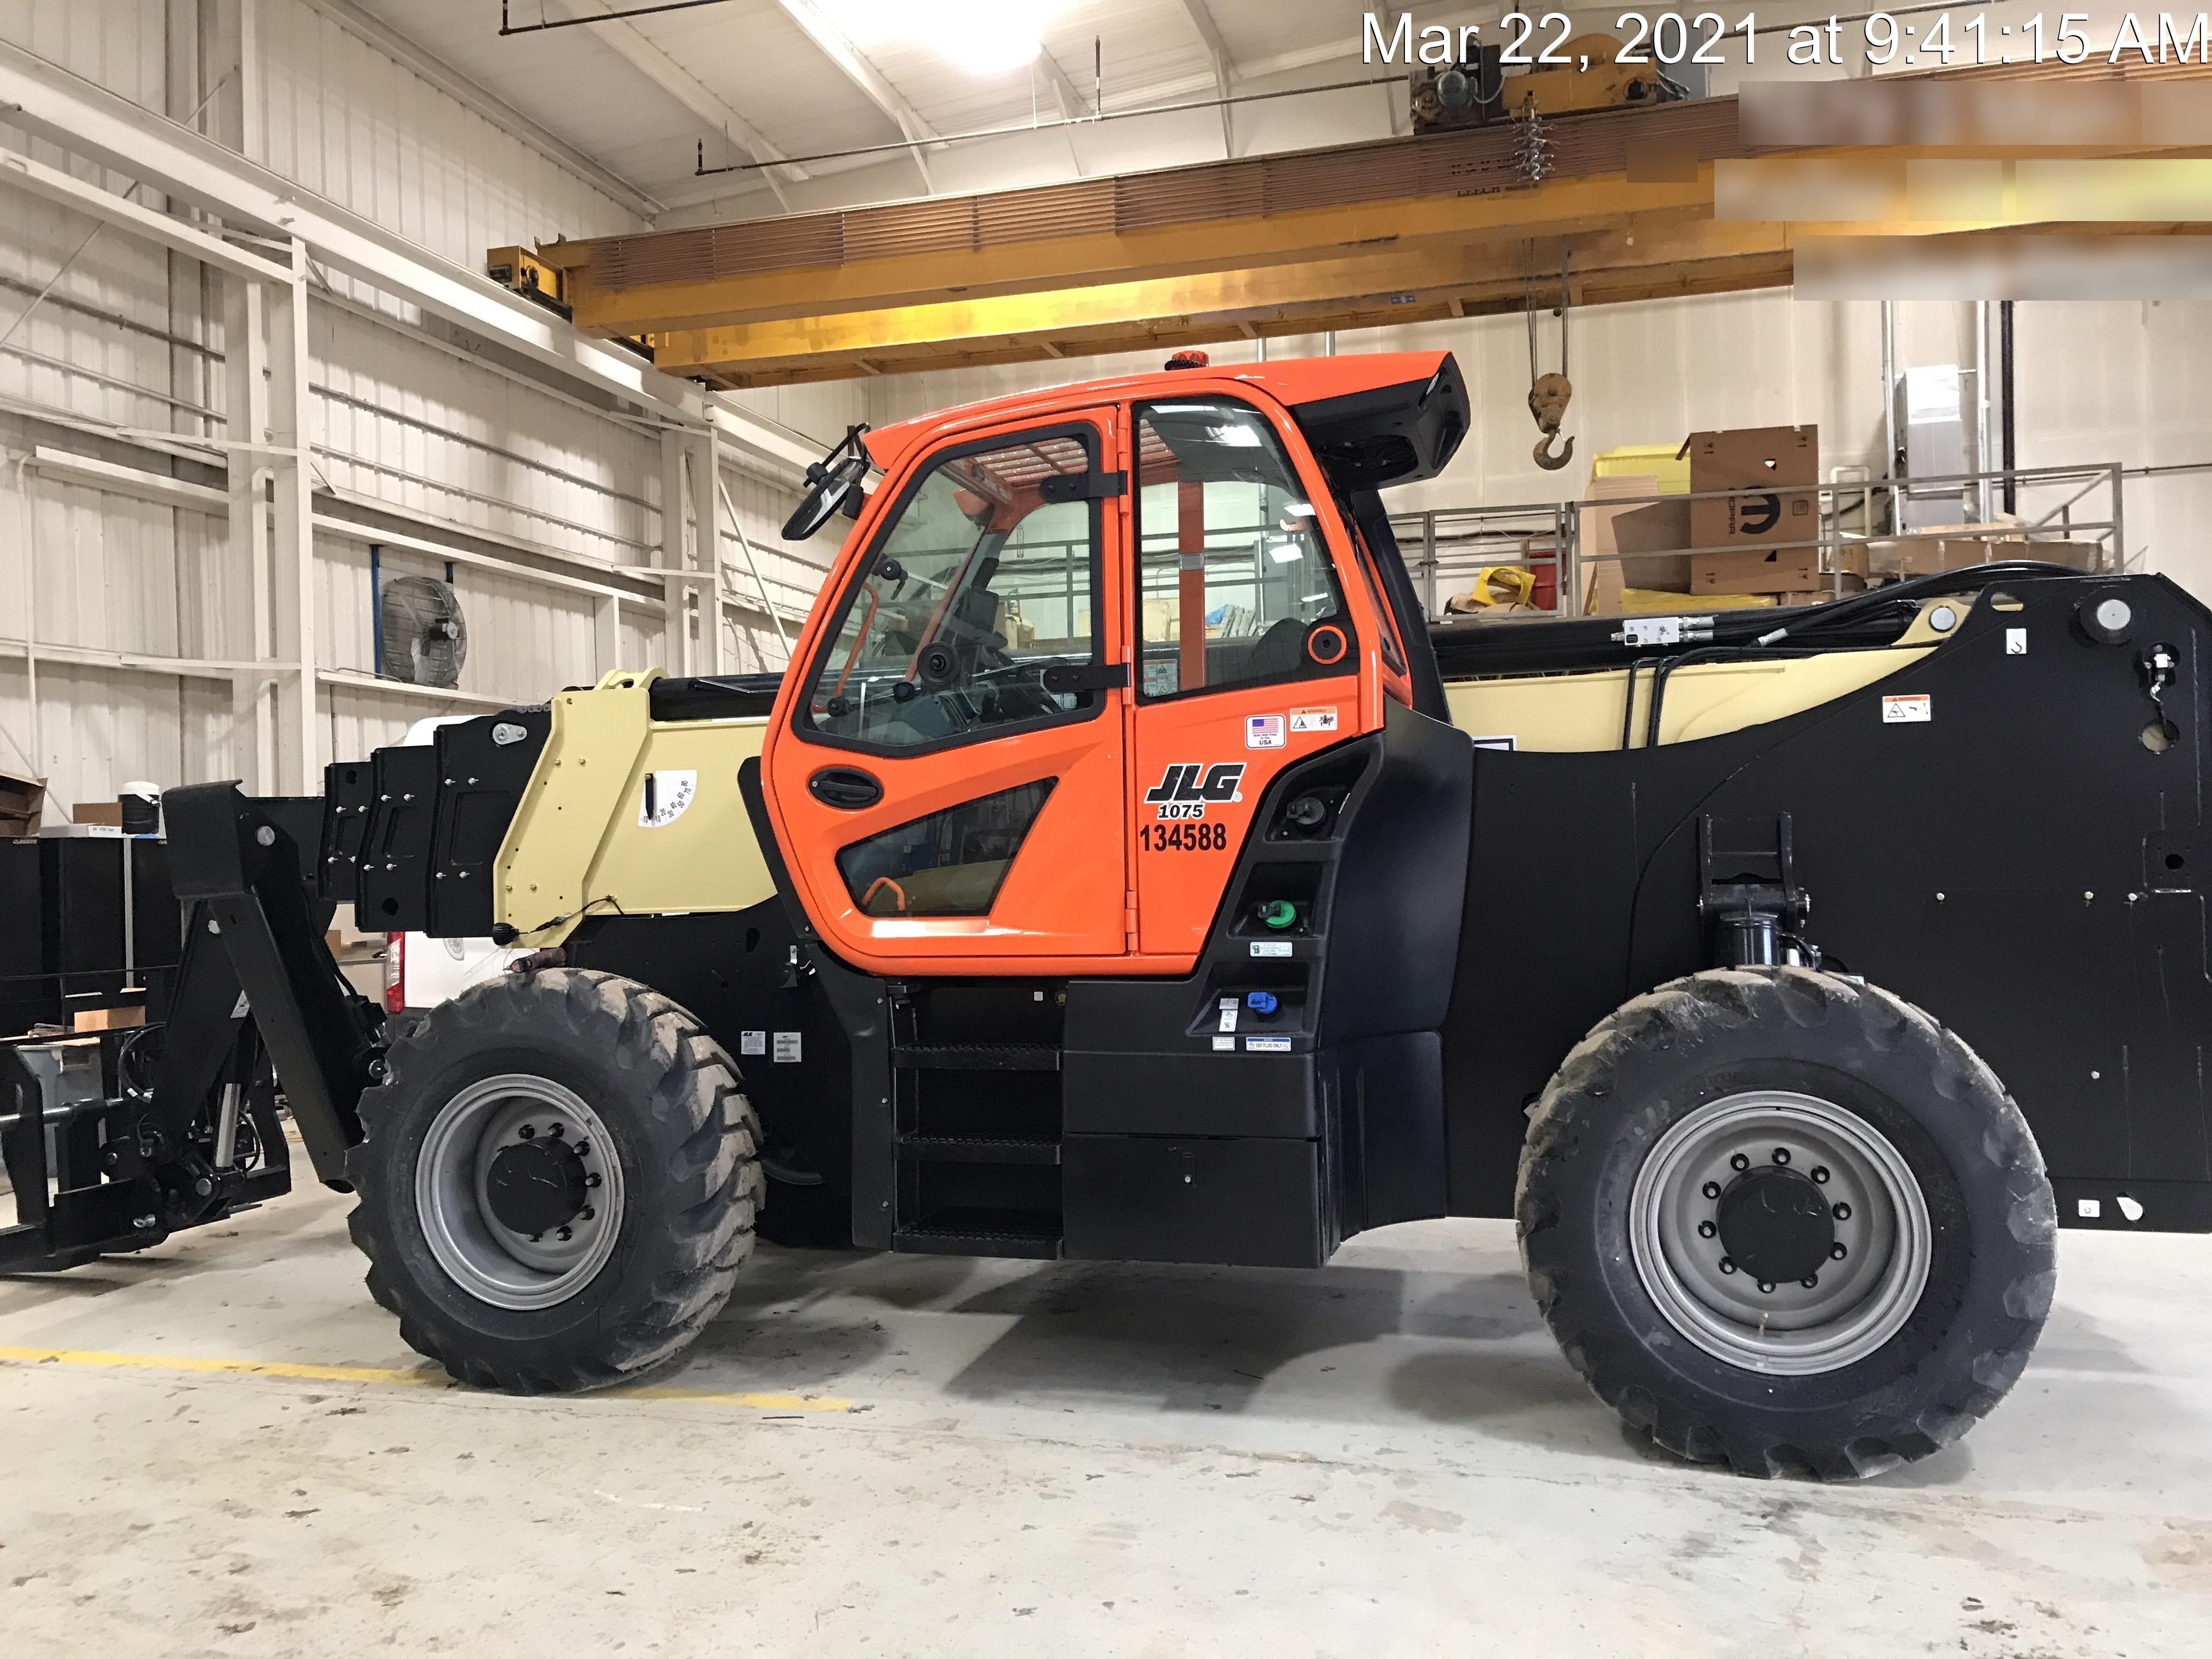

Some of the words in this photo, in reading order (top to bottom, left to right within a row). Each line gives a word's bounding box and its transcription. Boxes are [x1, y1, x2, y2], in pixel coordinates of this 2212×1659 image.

[1146, 764, 1245, 802] JLG
[660, 808, 666, 816] 20
[667, 810, 674, 818] 30
[1159, 804, 1203, 818] 1075
[1140, 823, 1227, 851] 134588
